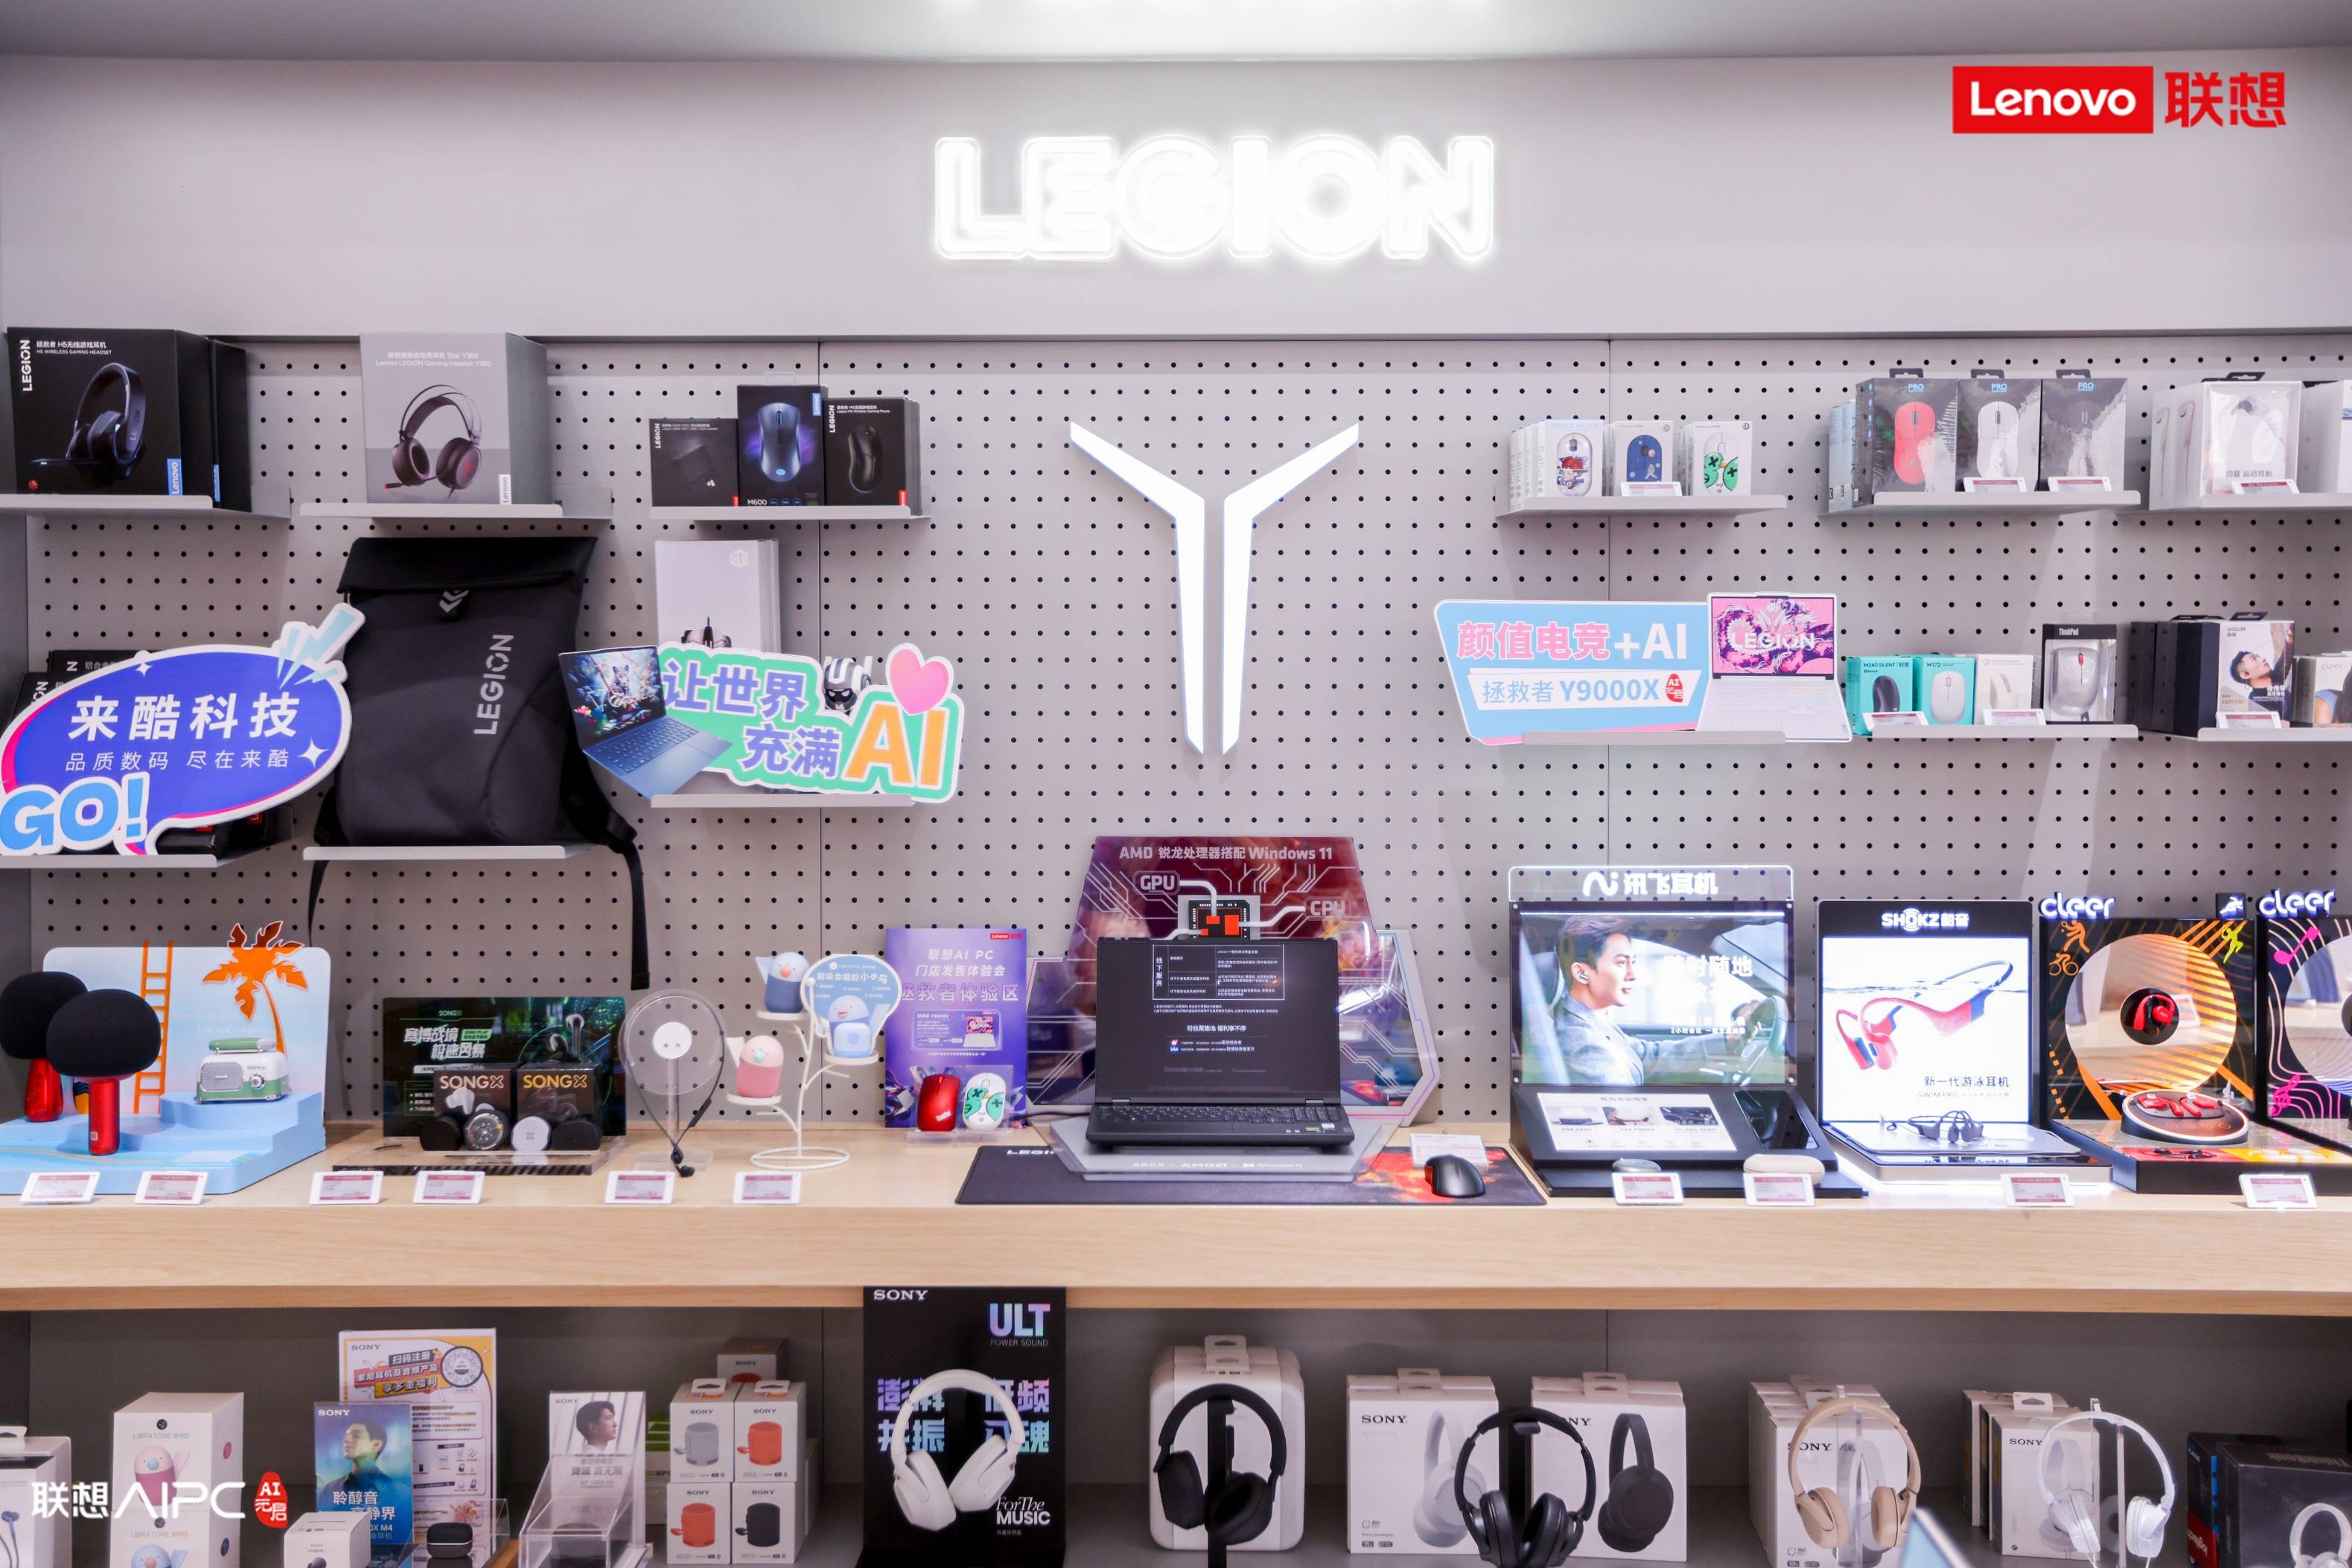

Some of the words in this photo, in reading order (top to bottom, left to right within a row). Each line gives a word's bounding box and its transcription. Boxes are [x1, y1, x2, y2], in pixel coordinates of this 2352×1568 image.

[936, 133, 1494, 261] LEGION
[19, 340, 33, 392] LEGION
[1456, 621, 1688, 660] 颜值电竞+AI
[1731, 631, 1815, 649] LEGION
[474, 634, 514, 736] LEGION
[661, 660, 809, 721] 让世界
[1482, 679, 1554, 704] 拯救者
[1559, 678, 1660, 701] Y9000X
[1668, 678, 1680, 686] AI
[68, 692, 300, 741] 来酷科技
[740, 721, 841, 780] 充满
[843, 702, 948, 790] AI
[65, 750, 169, 771] 品质数码
[187, 749, 290, 769] 尽在来酷
[0, 777, 146, 851] GO!
[1119, 847, 1153, 858] AMD
[1158, 846, 1246, 859] 锐龙处理器搭配
[1249, 847, 1316, 859] Windows
[1319, 847, 1333, 858] 11
[1140, 875, 1175, 890] GPU
[1624, 873, 1719, 895] 讯飞耳机
[1310, 900, 1345, 916] CPU
[2040, 892, 2114, 917] cleer
[2259, 890, 2335, 916] cleer
[1881, 911, 1940, 928] SHOKZ
[928, 949, 969, 960] 联想AI
[975, 949, 994, 960] PC
[915, 965, 1006, 978] 门店发售体验会
[440, 1074, 504, 1089] SONGX
[523, 1074, 588, 1089] SONGX
[1923, 1076, 2010, 1087] 新一代游泳耳机
[873, 1290, 928, 1301] SONY
[989, 1303, 1051, 1336] ULT
[392, 1351, 431, 1365] 扫码注册
[357, 1363, 439, 1383] 索尼耳机及音频产品
[1361, 1415, 1406, 1424] SONY
[333, 1491, 379, 1505] 聆醇音
[996, 1510, 1051, 1526] MUSIC
